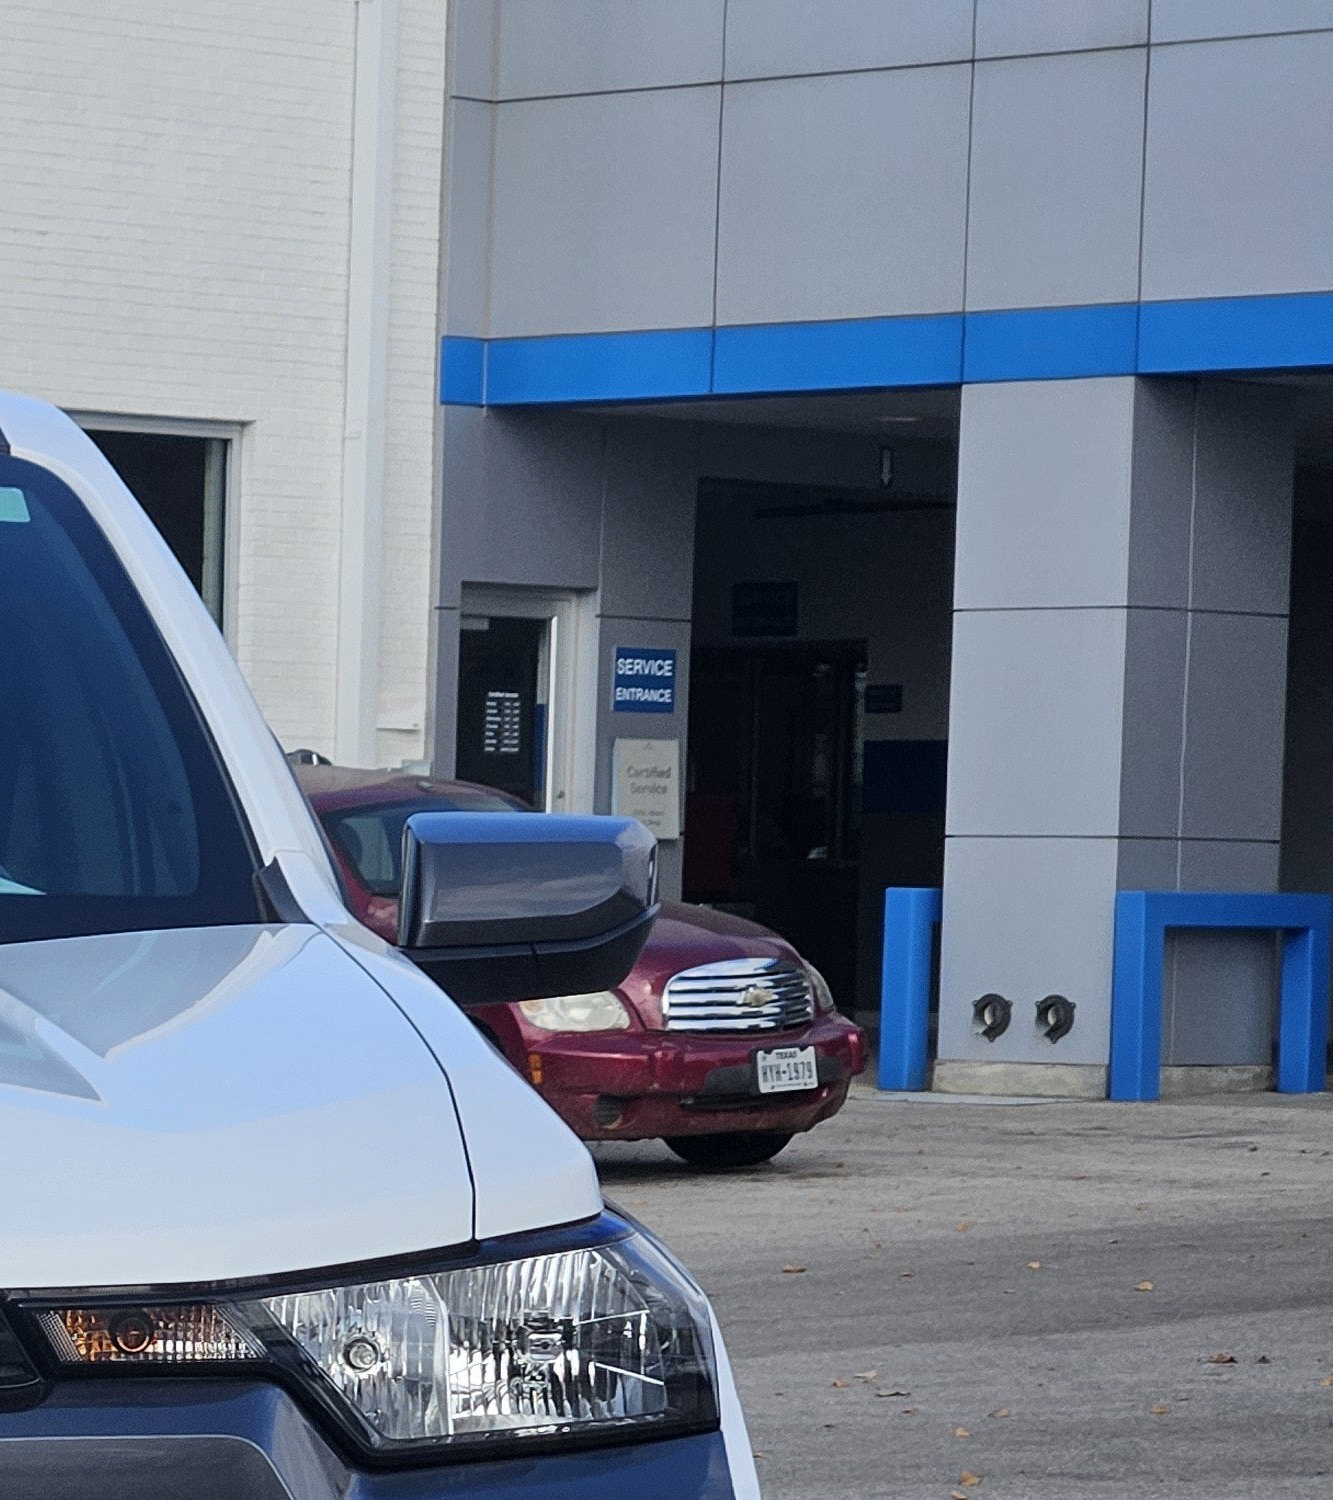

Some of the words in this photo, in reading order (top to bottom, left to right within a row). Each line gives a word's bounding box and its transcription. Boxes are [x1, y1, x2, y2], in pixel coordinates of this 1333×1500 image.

[616, 658, 673, 676] SERVICE
[615, 687, 672, 702] ENTRANCE
[775, 1050, 797, 1060] TEXAS
